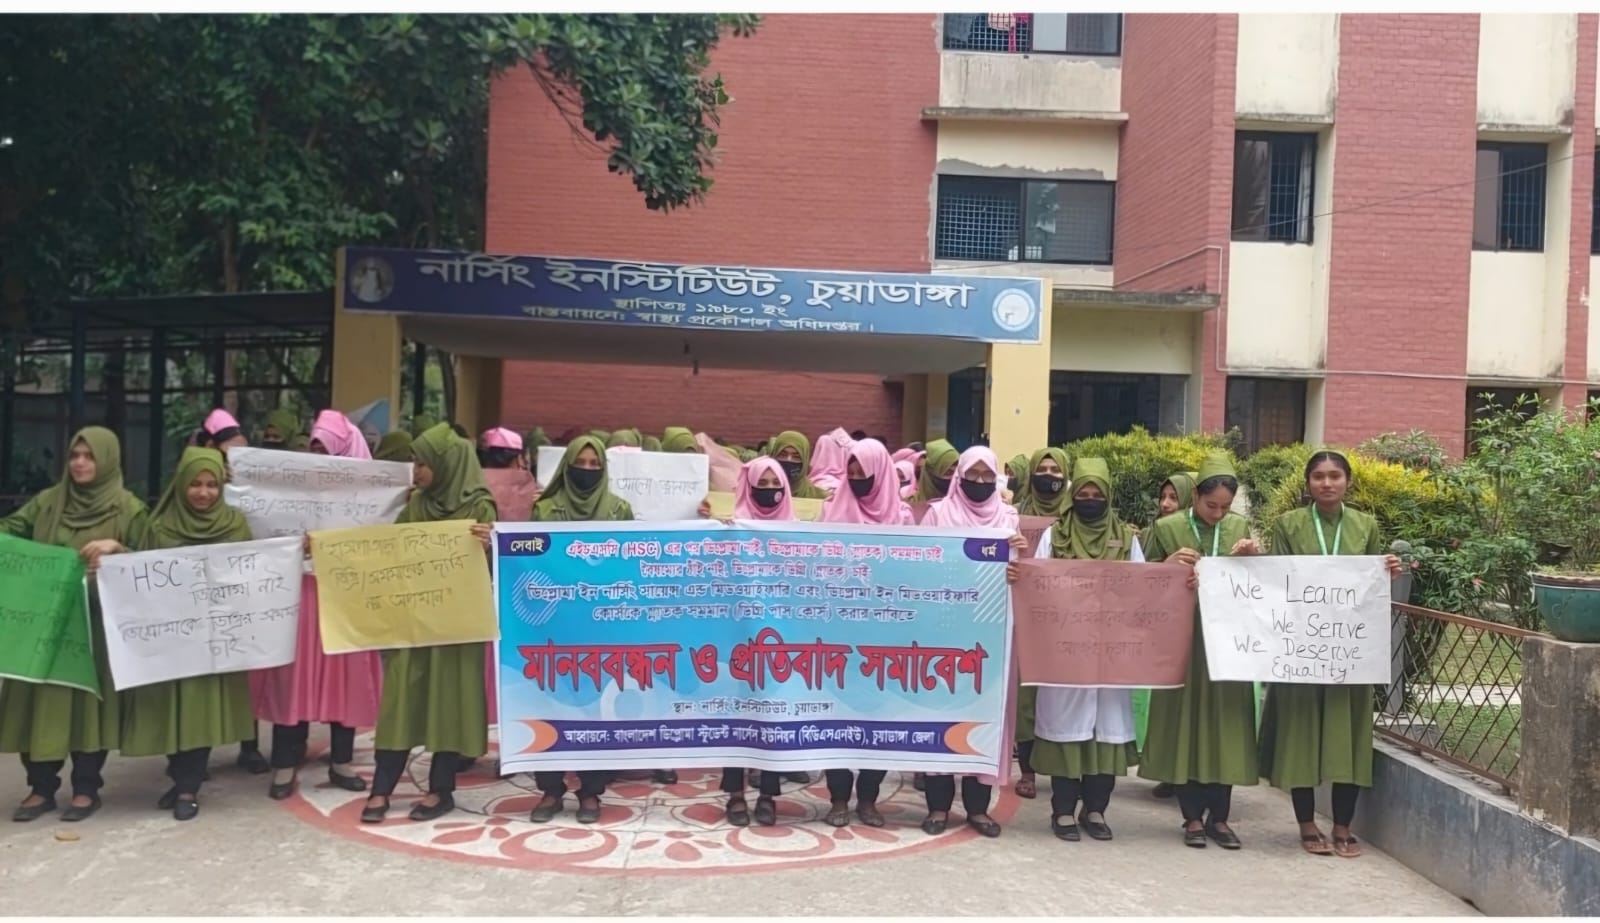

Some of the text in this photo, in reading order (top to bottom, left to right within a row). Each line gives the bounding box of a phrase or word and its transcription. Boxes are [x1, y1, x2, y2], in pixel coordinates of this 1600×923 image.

[416, 254, 975, 309] নার্সিং ইনস্টিটিউট, চুয়াডাঙ্গা
[695, 302, 753, 314] ১৯৮০
[510, 538, 545, 553] সেবাই
[622, 541, 662, 559] (HSC)
[578, 582, 598, 601] ইন
[601, 580, 638, 600] নার্সিং
[795, 585, 821, 599] এবং
[825, 583, 871, 600] ডিপ্লোমা
[873, 585, 893, 602] ইন
[1285, 574, 1360, 608] Learn
[836, 605, 869, 619] করার
[873, 604, 917, 620] দাবিতে
[1271, 609, 1368, 640] We Serve
[1234, 635, 1364, 661] We Deserve
[517, 626, 989, 695] মানববন্ধন ও প্রতিবাদ সমাবেশ
[701, 697, 731, 713] নার্সিং
[794, 701, 834, 715] চুয়াডাঙ্গা
[614, 728, 656, 744] বাংলাদেশ
[659, 724, 694, 743] ডিপ্লোমা
[760, 725, 795, 744] ইউনিয়ন
[871, 728, 908, 746] চুয়াডাঙ্গা
